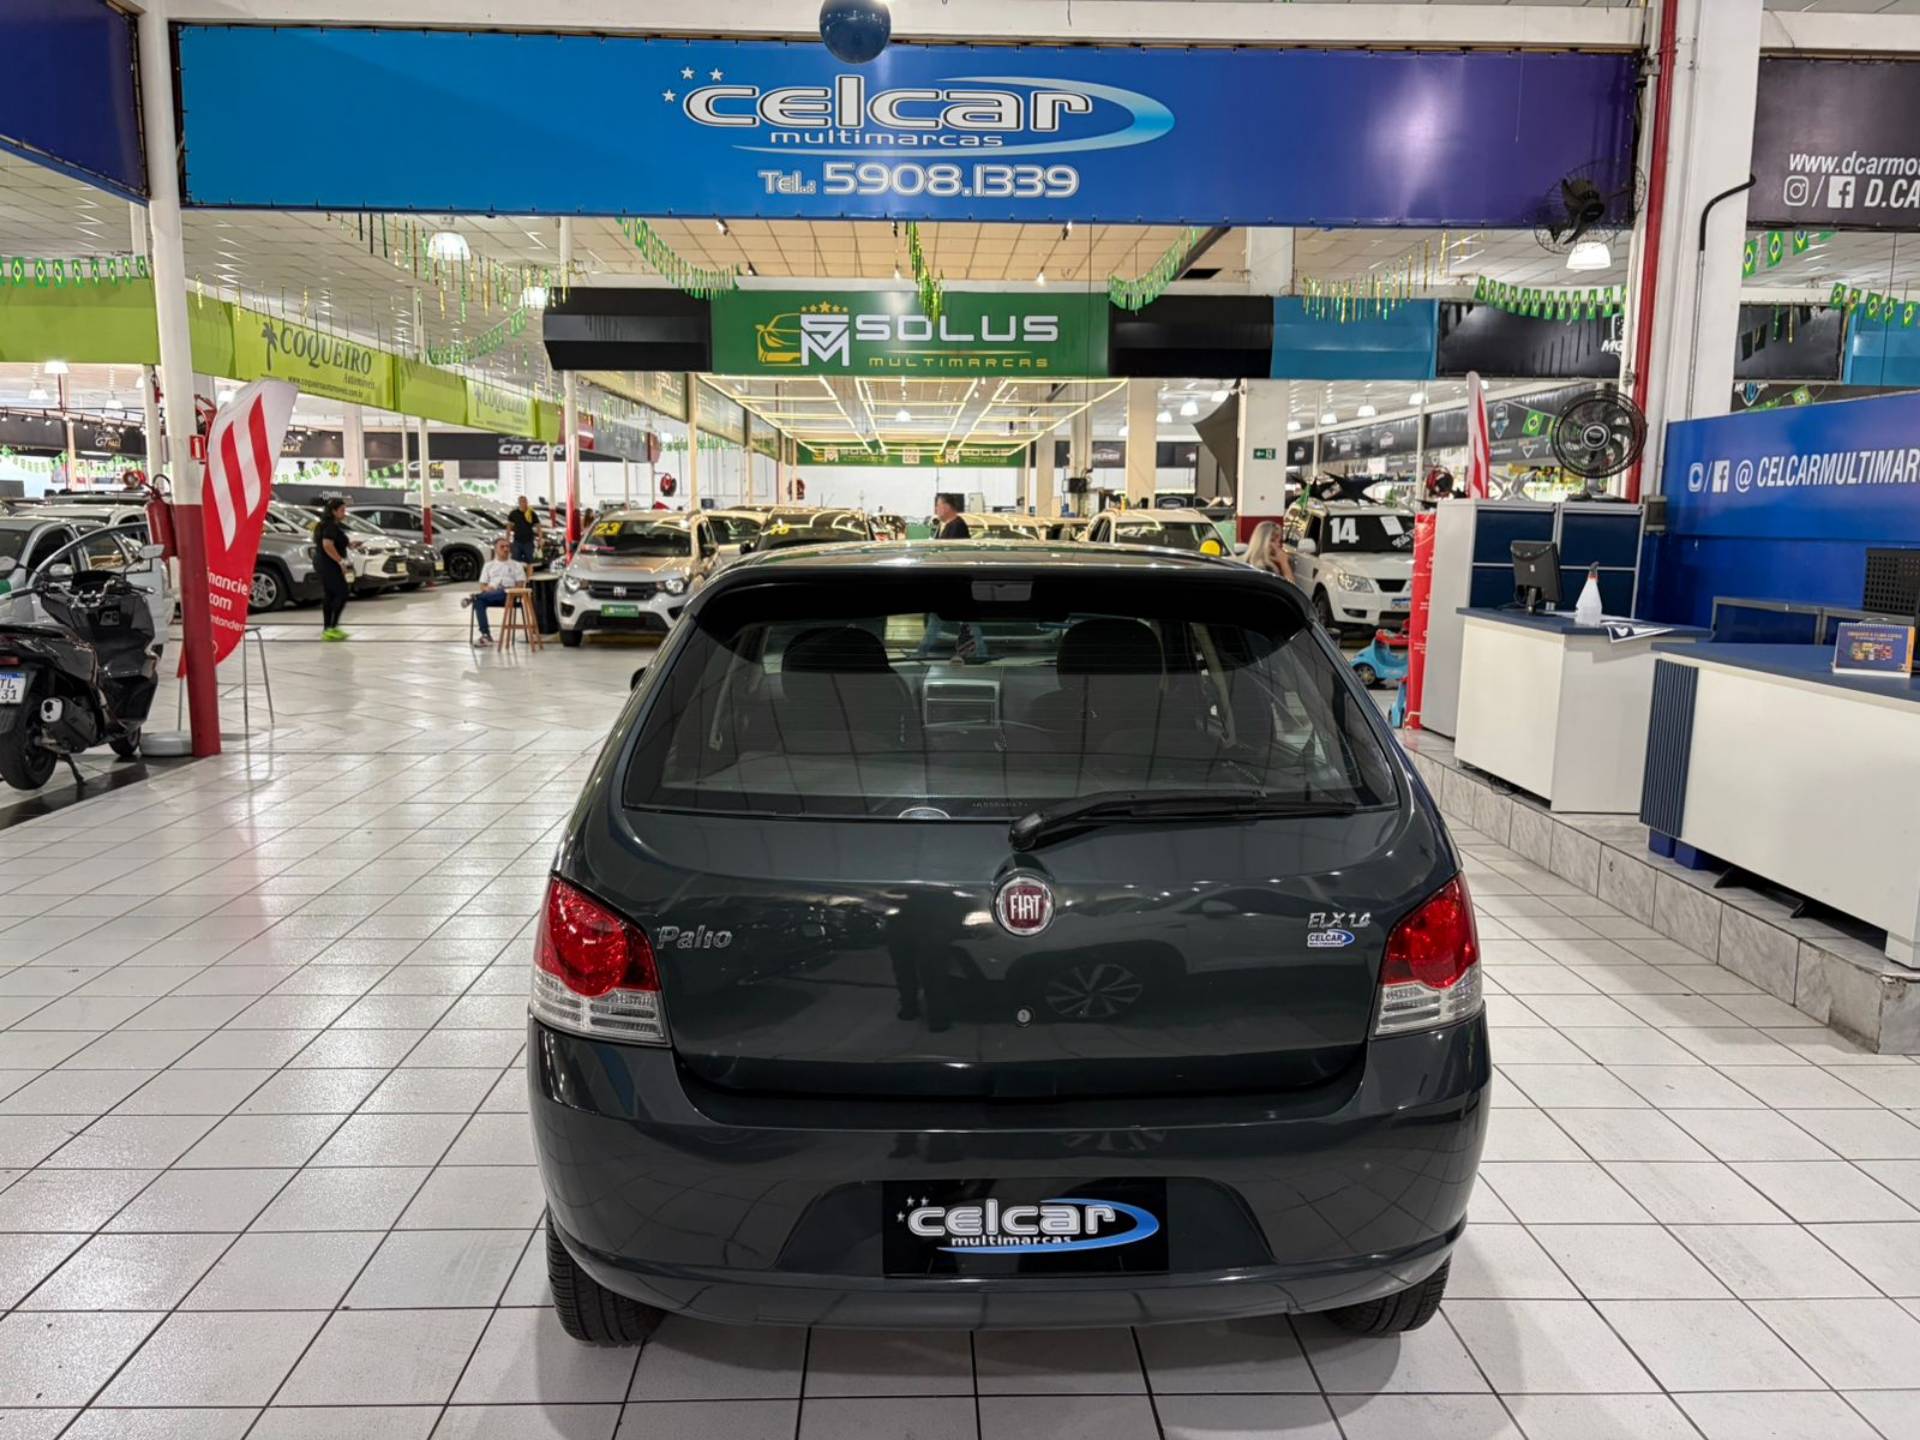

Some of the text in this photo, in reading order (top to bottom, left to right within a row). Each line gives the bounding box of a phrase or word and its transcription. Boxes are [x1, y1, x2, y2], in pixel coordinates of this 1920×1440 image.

[684, 74, 1094, 133] celcar
[770, 129, 1003, 148] multimarcas
[1789, 151, 1920, 176] www.dcarmo
[822, 161, 1080, 199] 5908.1339
[855, 314, 1059, 342] SOLUS
[280, 327, 372, 375] COQUEIRO
[868, 357, 1049, 368] MULTIMARCAS
[499, 444, 564, 455] CR CAR
[1757, 449, 1920, 487] CELCARMULTIMAR
[595, 521, 620, 536] 23
[1329, 517, 1360, 544] 14
[207, 570, 248, 595] nancie
[210, 614, 243, 632] ntander
[1010, 894, 1042, 920] FIAT
[656, 924, 733, 949] Palio
[908, 1198, 1116, 1237] celcar
[951, 1235, 1072, 1246] multimarcas
